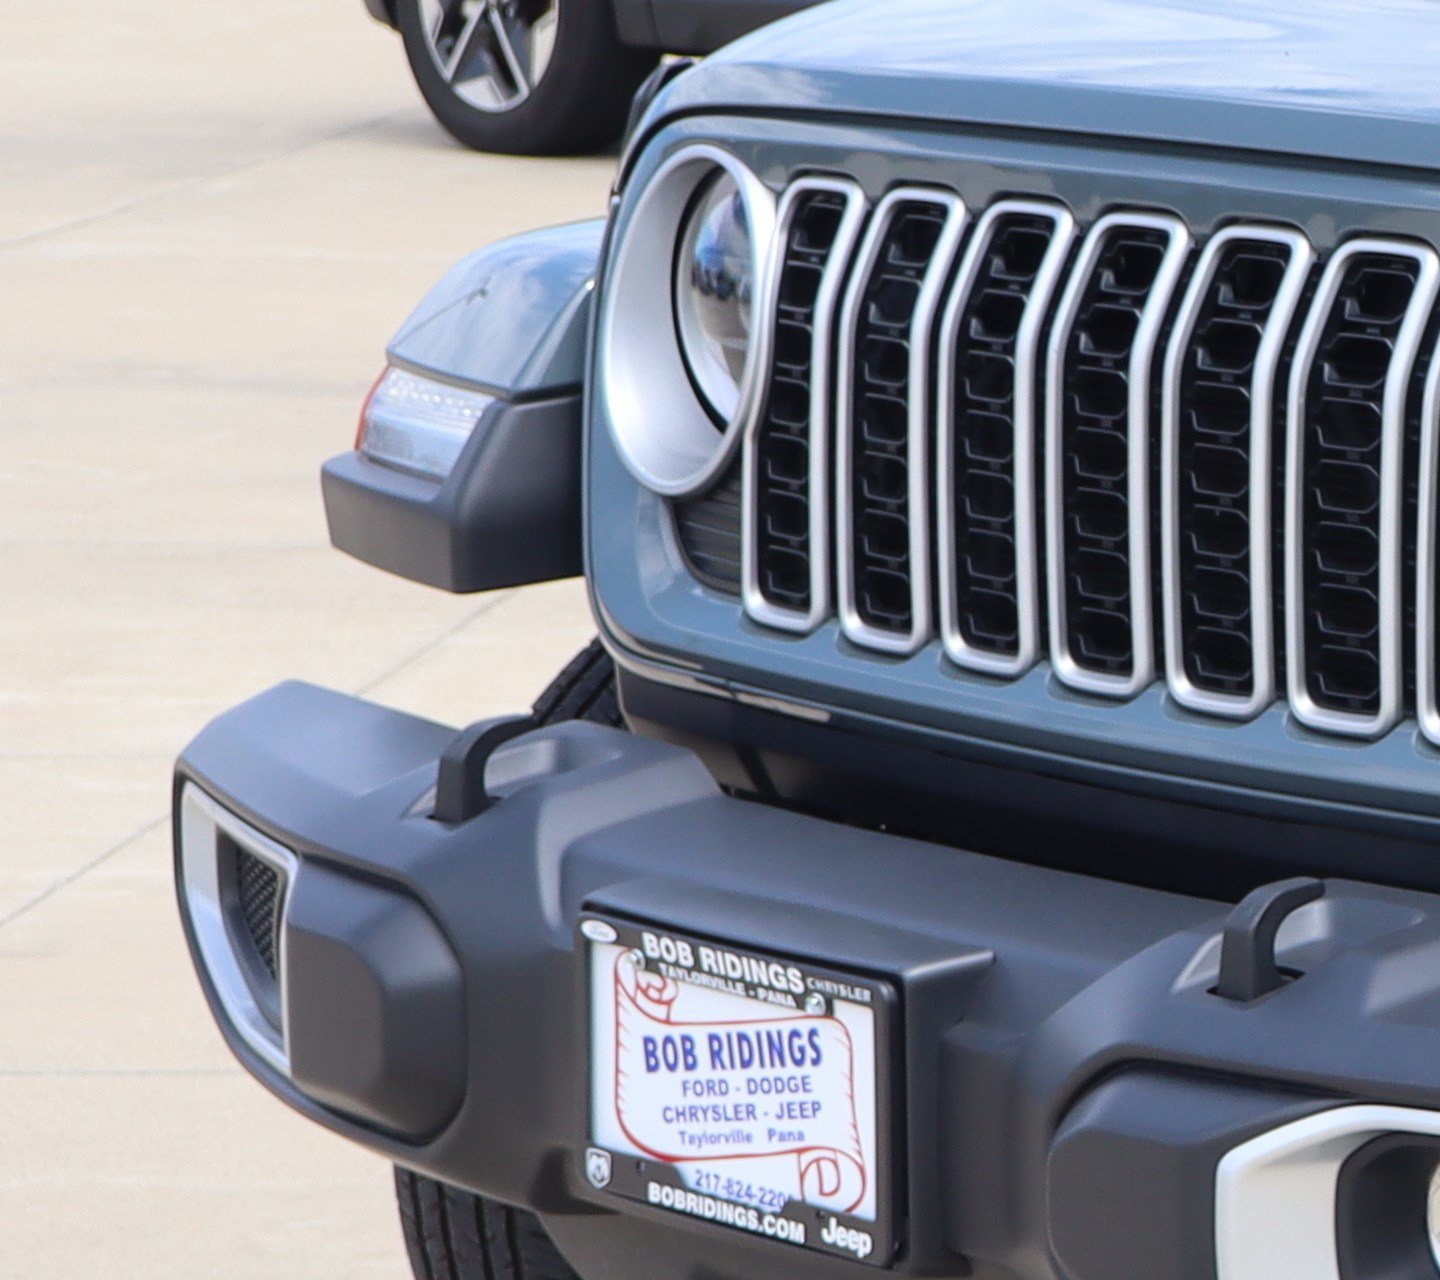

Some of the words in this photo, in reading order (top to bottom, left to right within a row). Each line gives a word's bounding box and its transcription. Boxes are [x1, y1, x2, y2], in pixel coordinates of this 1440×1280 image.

[641, 931, 694, 968] BOB
[698, 946, 805, 994] RIDINGS
[658, 963, 745, 996] TAYLORVILLE
[757, 987, 798, 1009] PANA
[643, 1034, 698, 1073] BOB
[708, 1027, 823, 1071] RIDINGS
[682, 1079, 729, 1097] FORD
[747, 1076, 812, 1095] DODGE
[662, 1104, 757, 1124] CHRYSLER
[775, 1101, 822, 1121] JEEP
[679, 1129, 753, 1148] Taylorville
[768, 1128, 805, 1143] Pana
[647, 1181, 806, 1245] BOBRIDINGS.COM
[821, 1217, 873, 1258] Jeep
